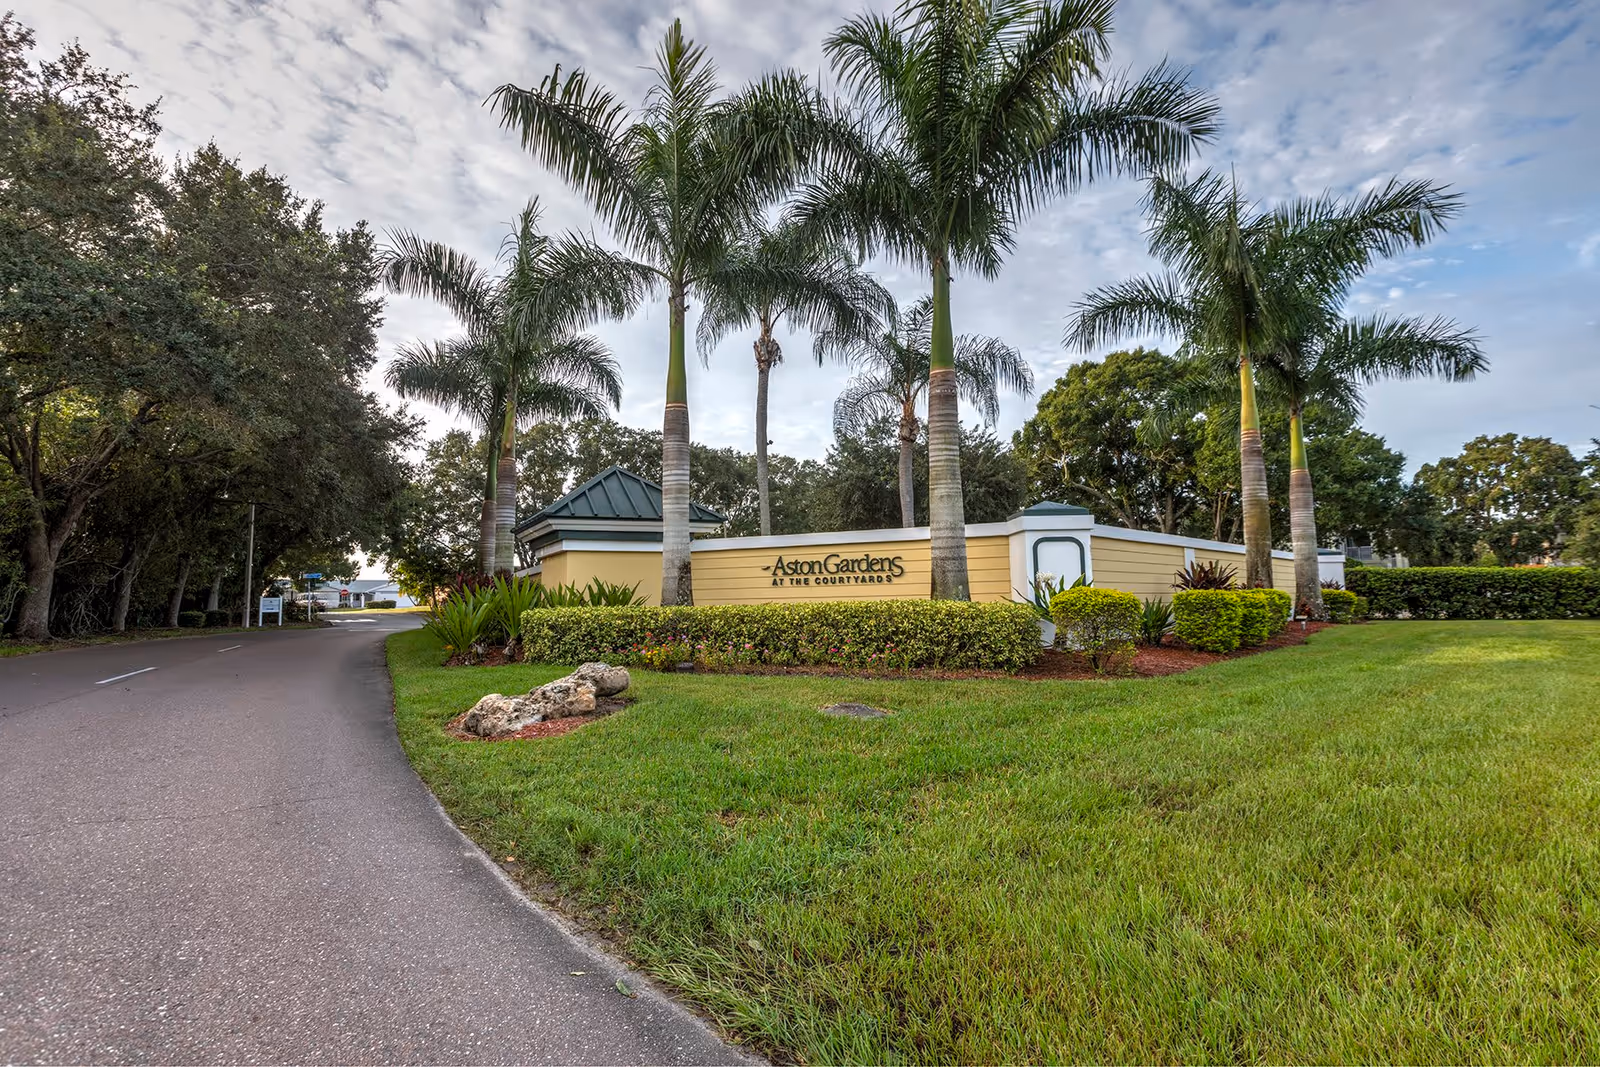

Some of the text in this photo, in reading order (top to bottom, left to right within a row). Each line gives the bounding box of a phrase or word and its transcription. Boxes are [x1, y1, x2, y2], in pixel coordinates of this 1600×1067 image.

[772, 575, 893, 586] AT THE COURTYARDS
